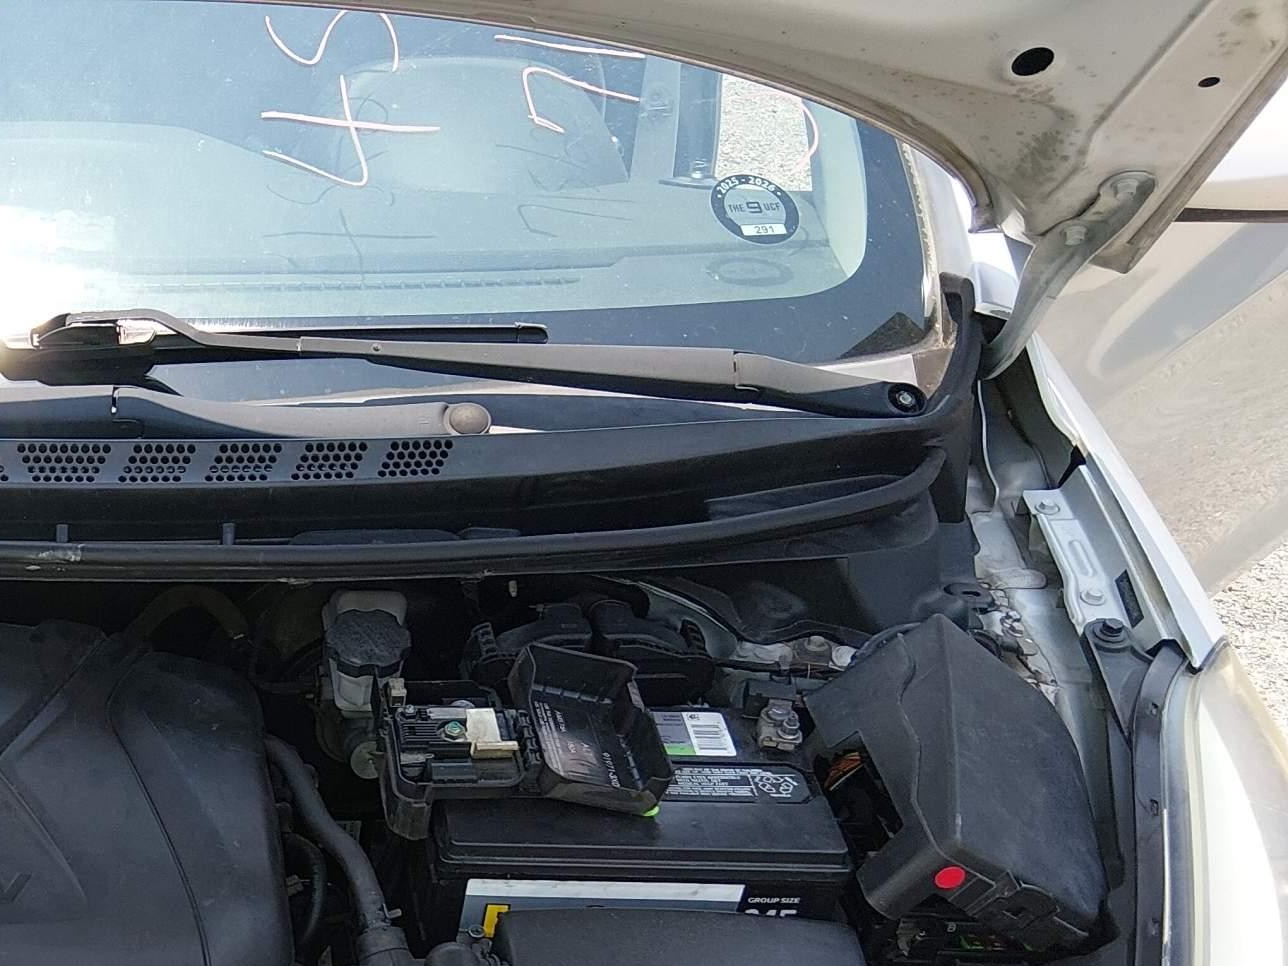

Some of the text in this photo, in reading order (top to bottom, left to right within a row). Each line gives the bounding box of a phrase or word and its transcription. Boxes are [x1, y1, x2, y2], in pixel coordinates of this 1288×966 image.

[717, 177, 739, 194] 2025
[748, 176, 777, 191] 2026
[728, 204, 744, 213] THE
[763, 202, 780, 211] UCF
[754, 225, 775, 234] 291
